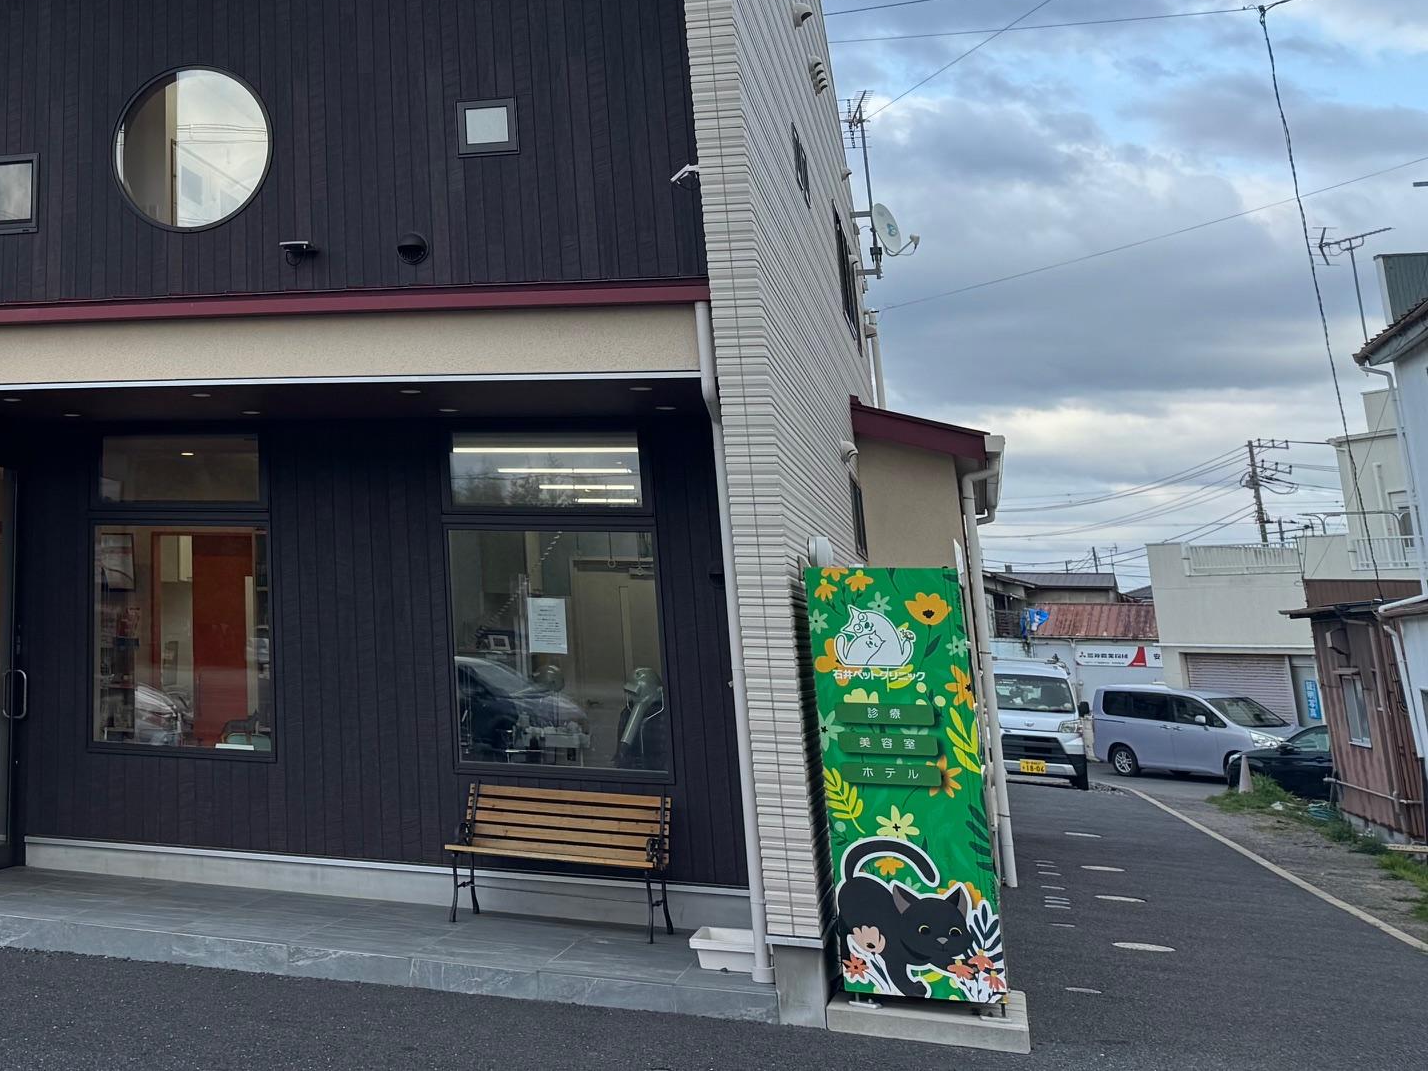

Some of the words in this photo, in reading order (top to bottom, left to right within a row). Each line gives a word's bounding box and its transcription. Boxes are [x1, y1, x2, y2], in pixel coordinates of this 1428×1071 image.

[833, 669, 926, 681] 石井ペットクリニック
[862, 767, 919, 779] ホテル
